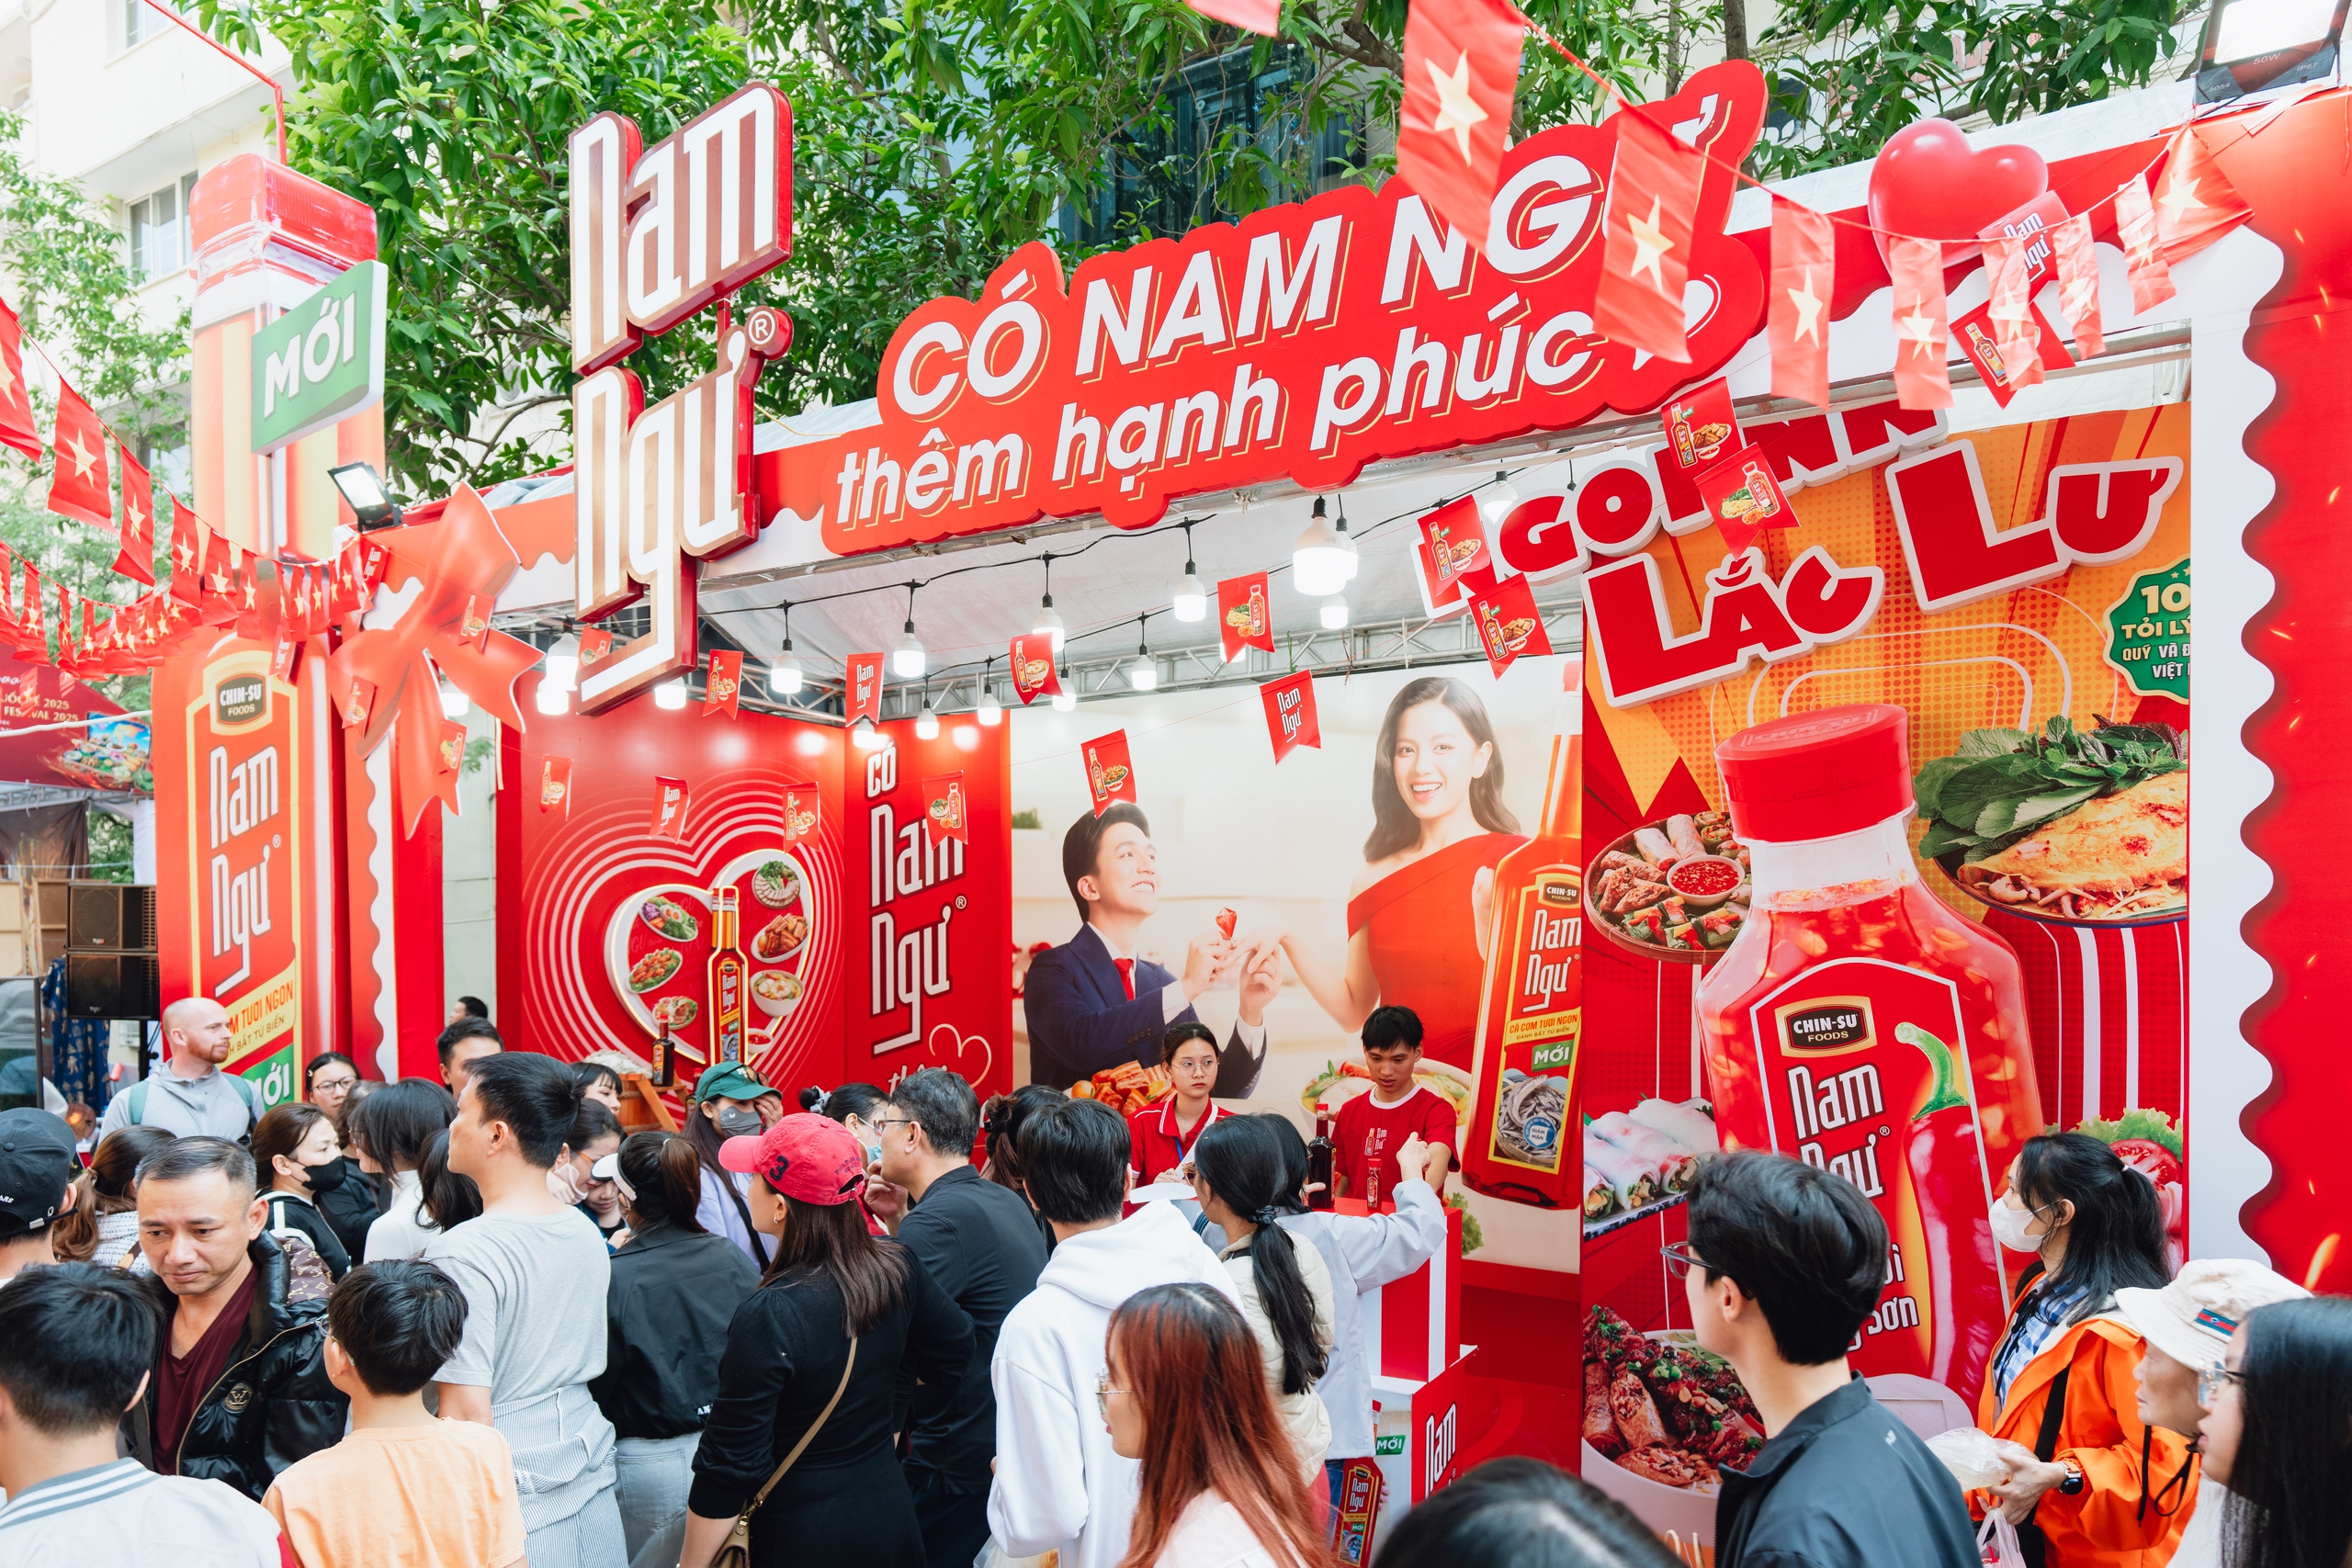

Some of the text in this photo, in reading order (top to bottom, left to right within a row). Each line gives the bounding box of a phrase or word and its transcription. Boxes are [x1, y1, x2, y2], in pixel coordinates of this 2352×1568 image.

[2254, 52, 2281, 65] 50W
[2297, 62, 2320, 72] IP67
[573, 90, 775, 362] Nam
[893, 93, 1720, 416] CÓ NAM NG
[2024, 233, 2052, 283] gư
[264, 290, 356, 419] MỚI
[836, 291, 1595, 525] thêm hạnh phúc
[575, 327, 749, 702] Ngư
[1586, 552, 1874, 699] LẮC
[2120, 616, 2163, 639] TỎI
[2121, 643, 2152, 661] QUÝ
[2158, 642, 2178, 660] VÀ
[2152, 661, 2184, 681] VIỆT
[43, 697, 70, 711] 2025
[220, 683, 262, 706] CHIN-SU
[228, 704, 255, 716] FOODS
[1276, 687, 1301, 715] Nam
[1281, 707, 1302, 743] Ngư
[867, 741, 897, 798] CÓ
[210, 745, 278, 850] Nam
[1546, 886, 1577, 897] CHIN-SU
[211, 844, 272, 998] Ngư
[1530, 909, 1581, 952] Nam
[265, 979, 293, 1016] NGON
[872, 905, 952, 1055] Ngư
[1522, 953, 1572, 1013] Ngư
[1556, 1013, 1578, 1026] NGON
[1793, 1013, 1858, 1034] CHIN-SU
[1807, 1030, 1849, 1043] FOODS
[1533, 1044, 1570, 1065] MỚI
[254, 1061, 290, 1107] ỚI
[1787, 1064, 1884, 1140] Nam
[769, 1155, 789, 1181] 3
[1376, 1437, 1403, 1450] MỚI
[1425, 1403, 1457, 1501] Nam
